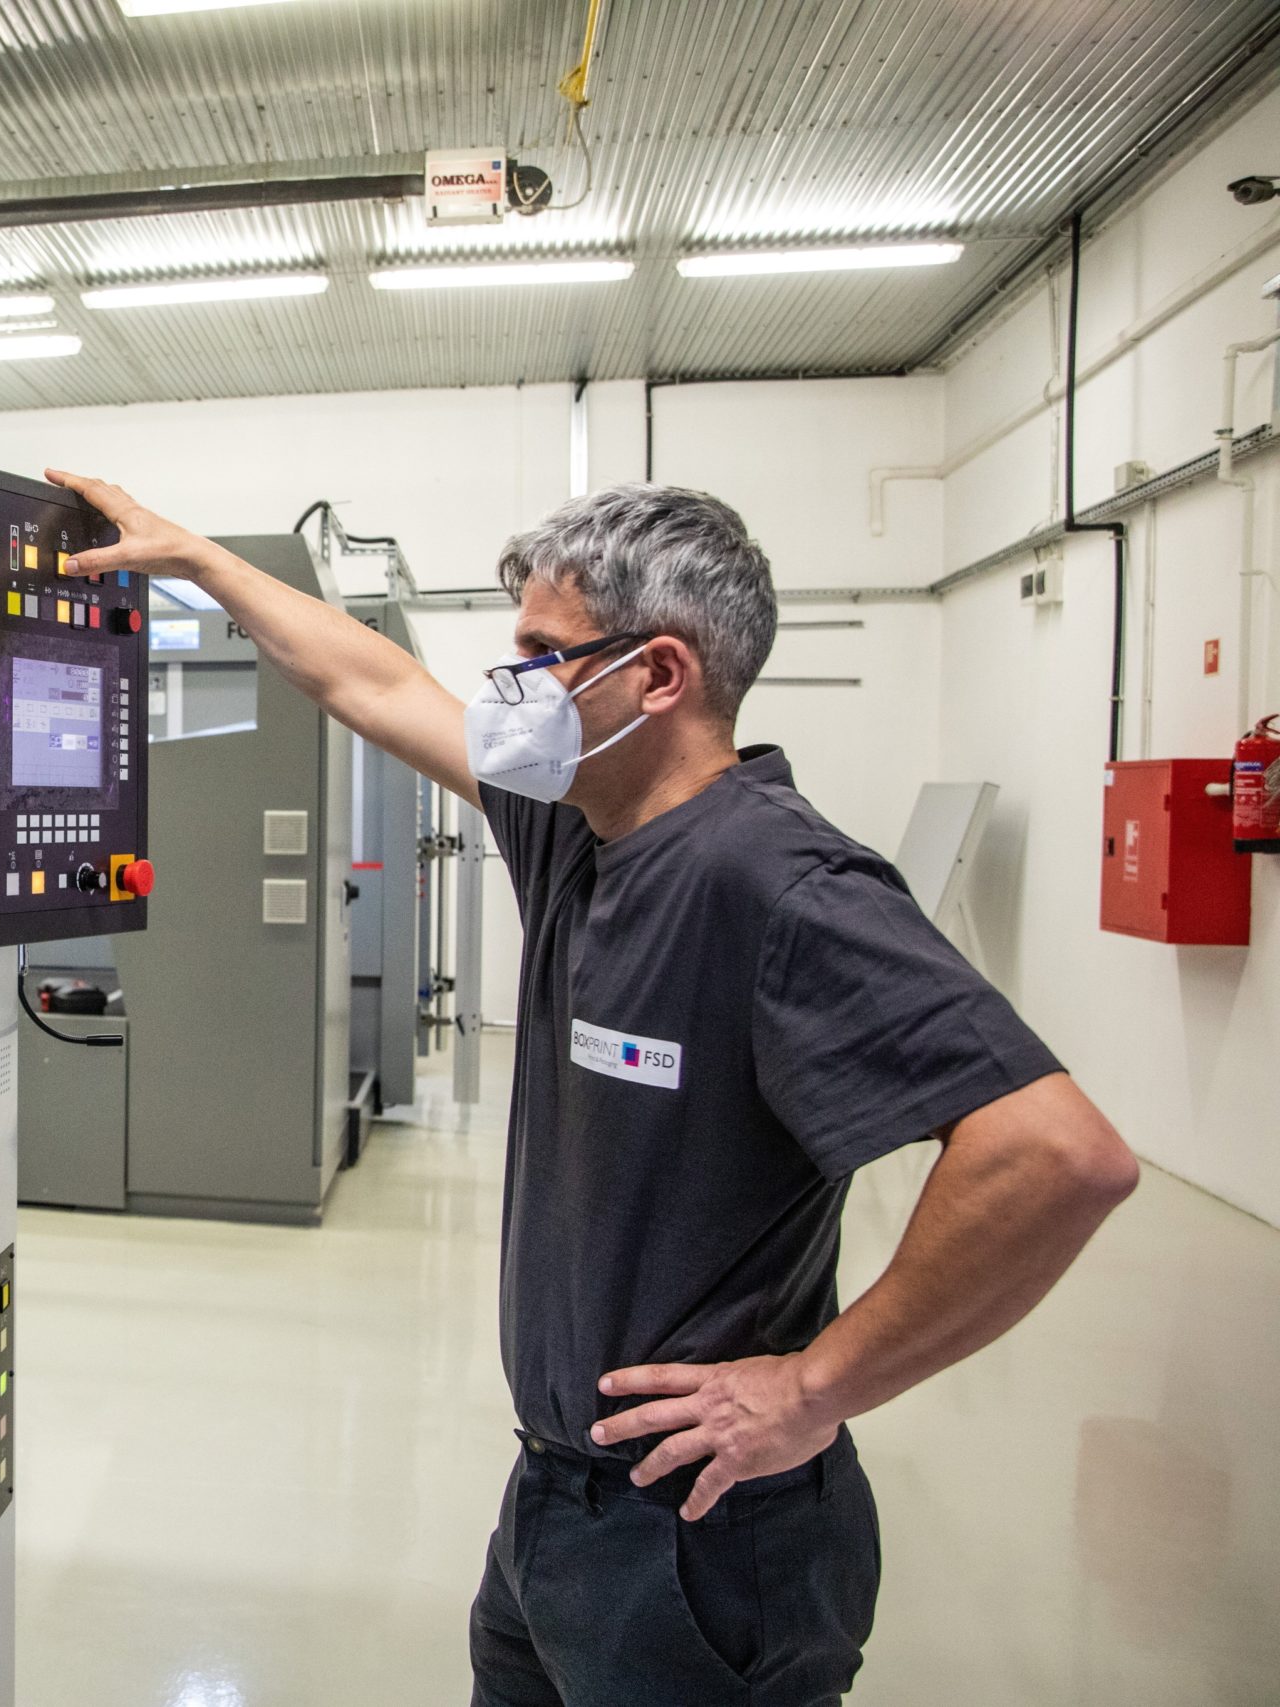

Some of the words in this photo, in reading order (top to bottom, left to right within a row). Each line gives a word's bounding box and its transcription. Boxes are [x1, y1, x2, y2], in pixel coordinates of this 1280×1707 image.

[431, 173, 485, 187] OMEGA
[573, 1032, 619, 1058] BOXPRINT
[644, 1050, 675, 1068] FSD
